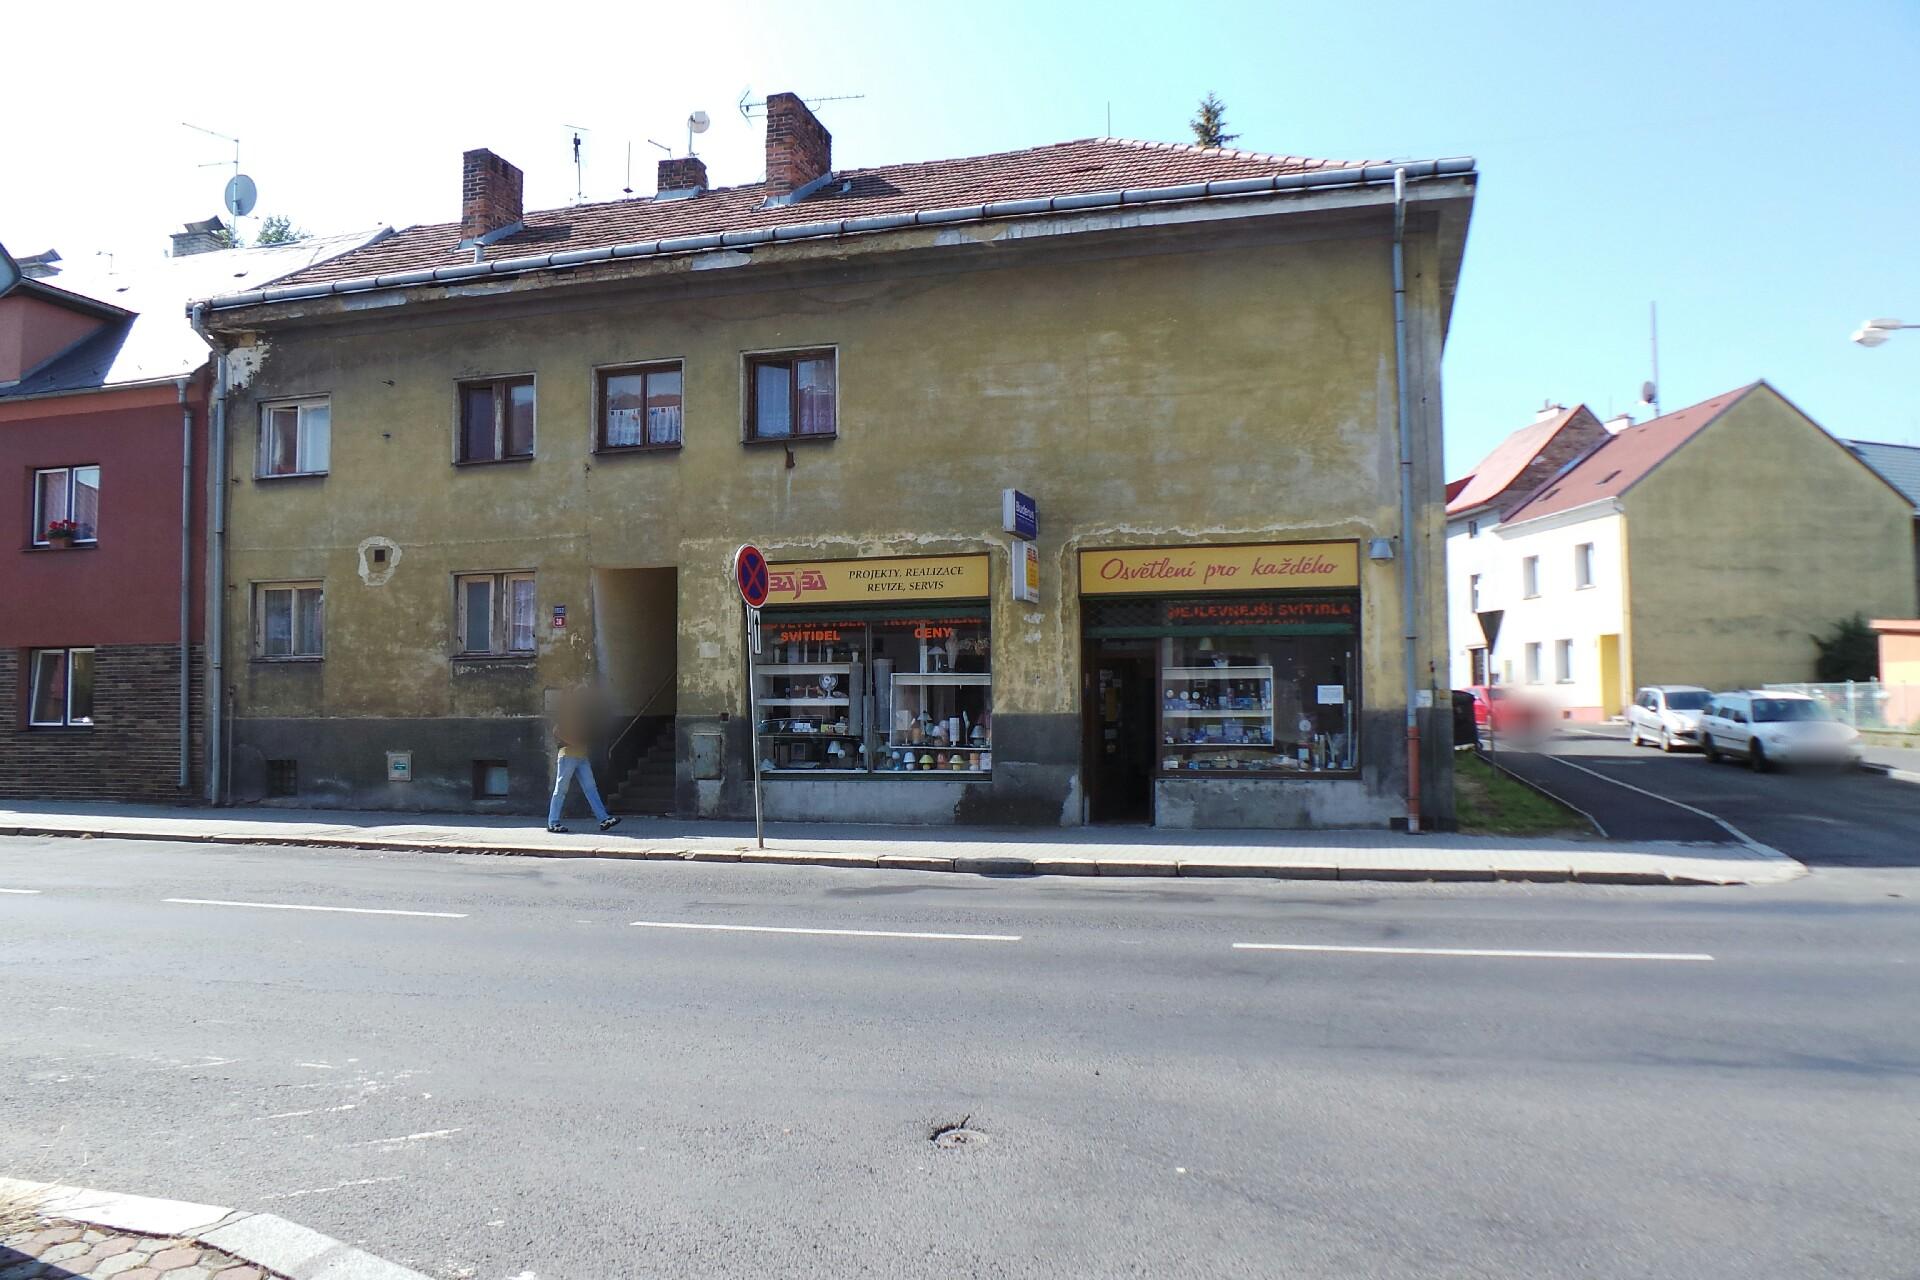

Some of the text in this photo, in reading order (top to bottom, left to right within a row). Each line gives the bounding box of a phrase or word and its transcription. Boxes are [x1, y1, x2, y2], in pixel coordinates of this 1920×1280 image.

[905, 566, 964, 577] REALIZACE
[1100, 555, 1337, 584] Osvětlení pro každého
[867, 580, 944, 592] REVIZE, SERVIS
